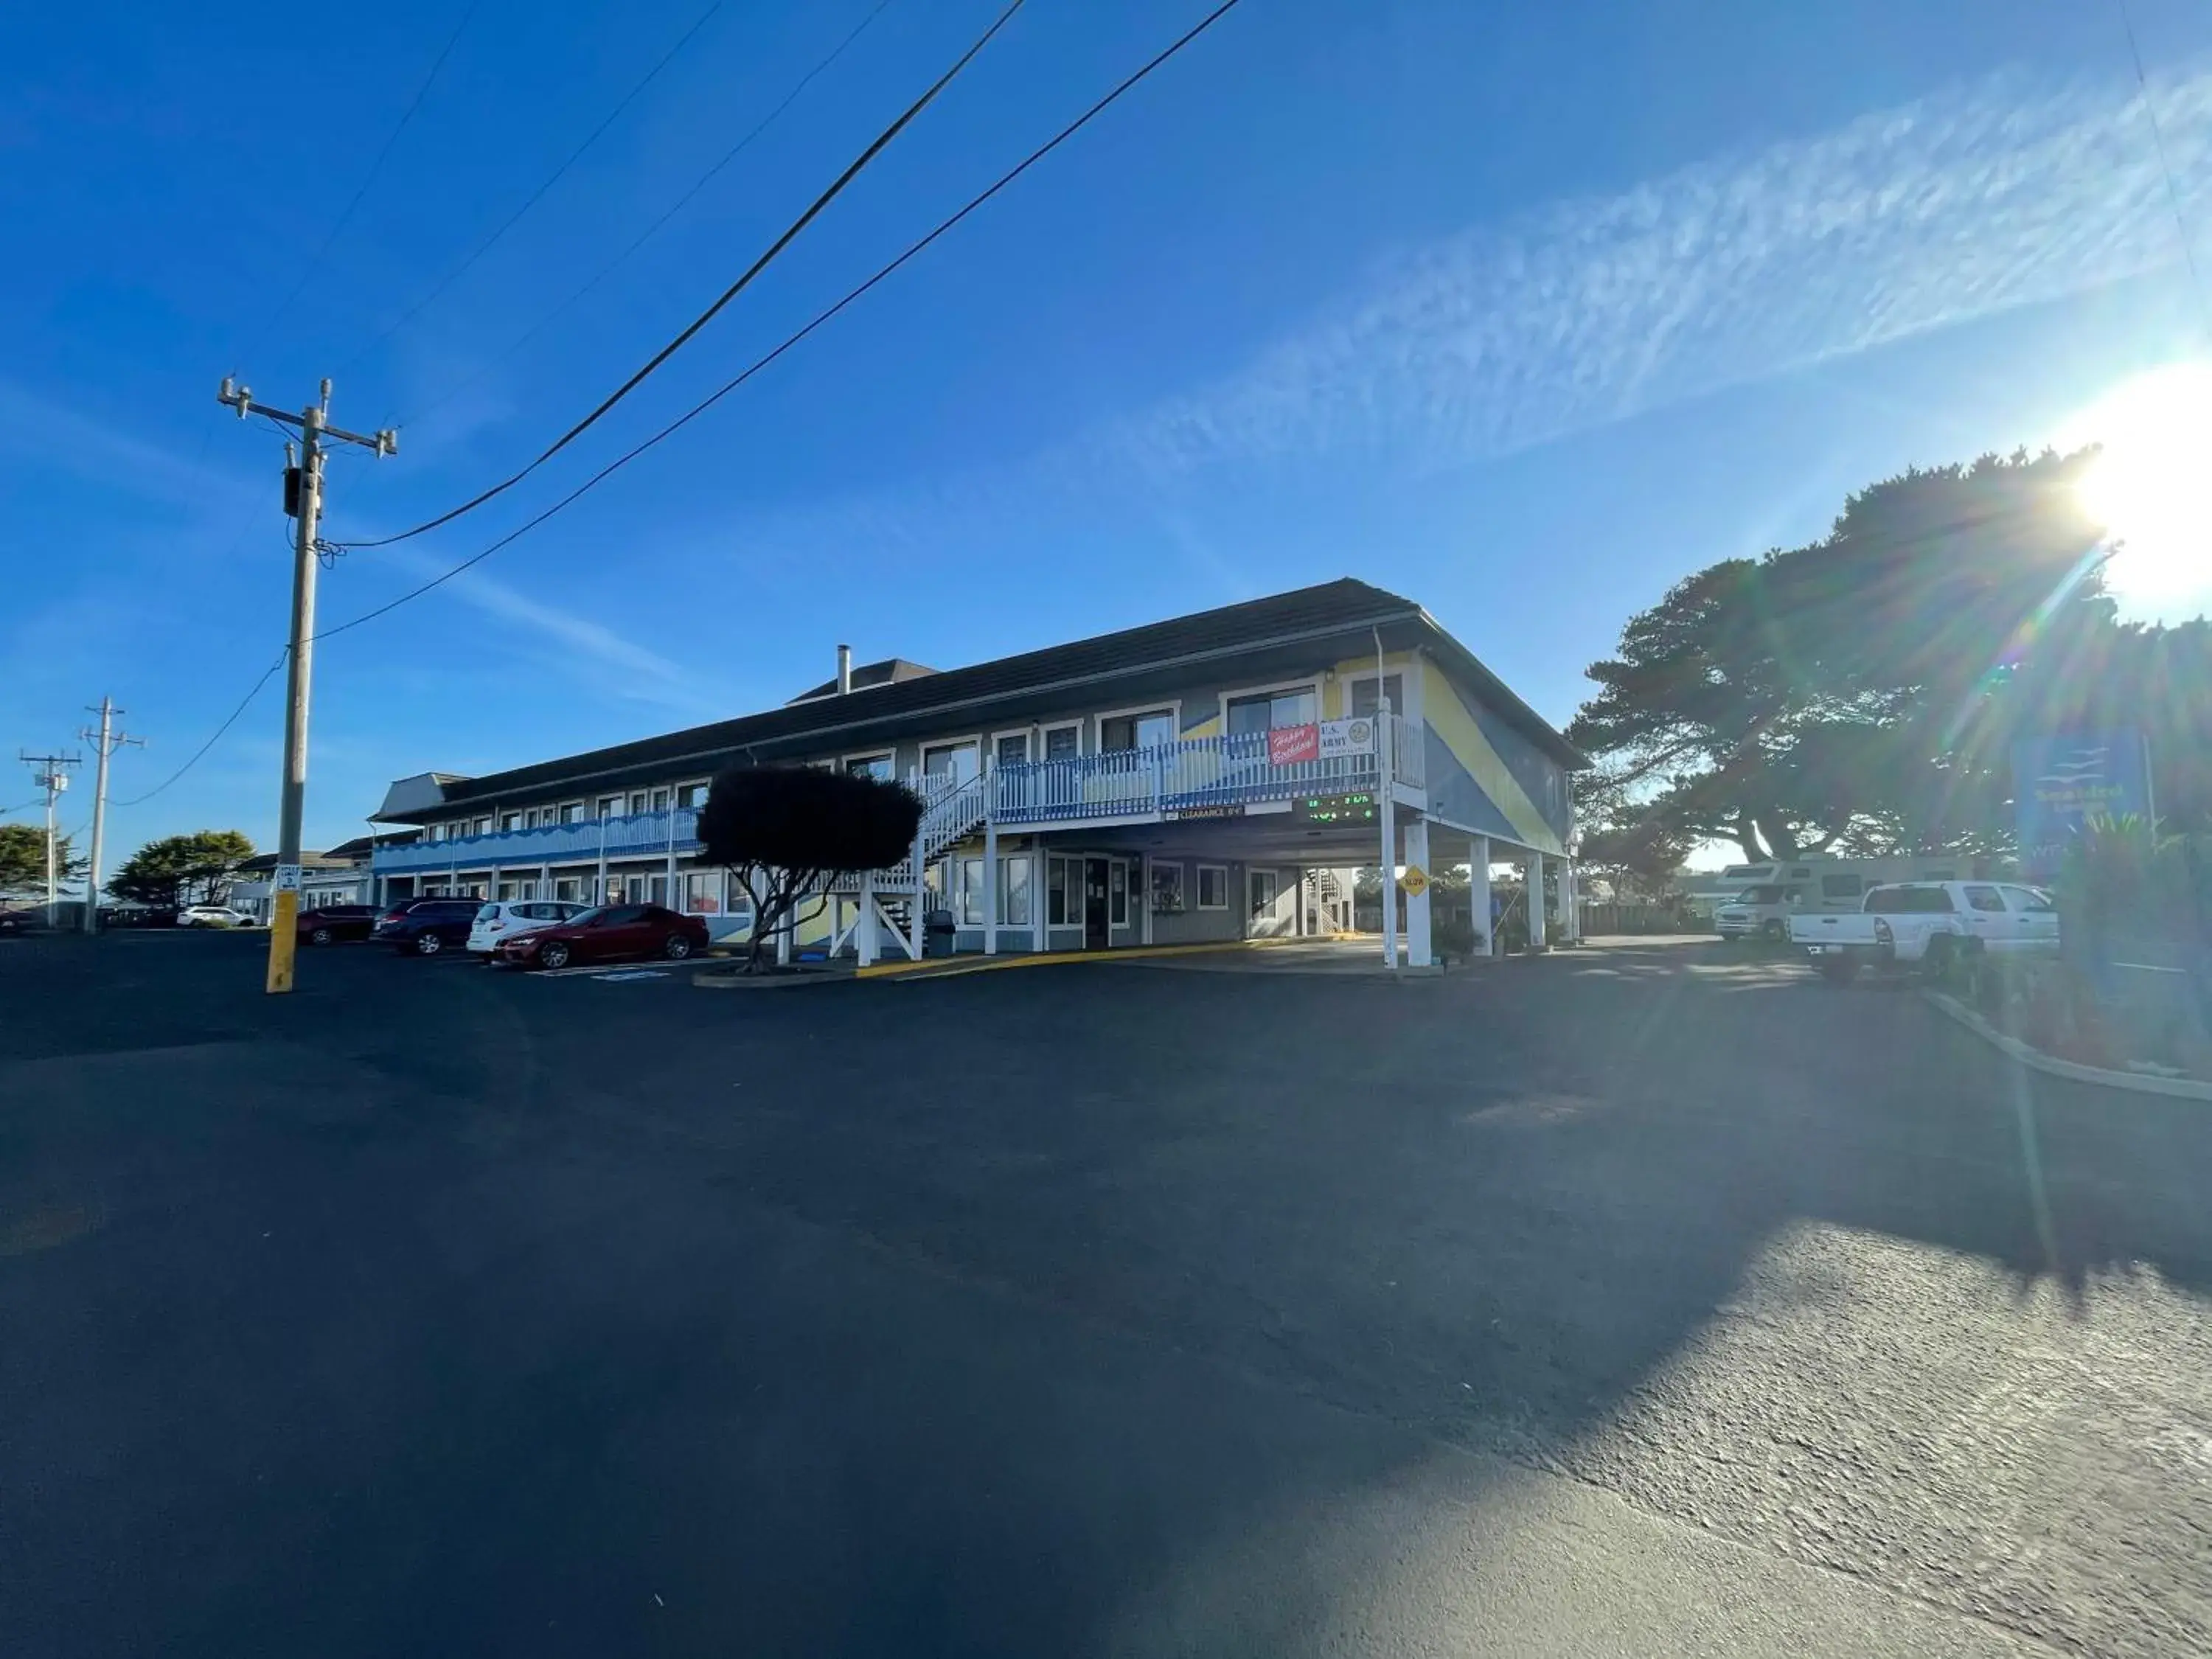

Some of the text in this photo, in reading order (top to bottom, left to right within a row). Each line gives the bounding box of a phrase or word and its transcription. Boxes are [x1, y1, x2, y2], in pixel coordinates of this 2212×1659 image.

[1273, 727, 1306, 747] Happy
[1321, 736, 1348, 748] ARMY
[1405, 877, 1425, 886] SLOW
